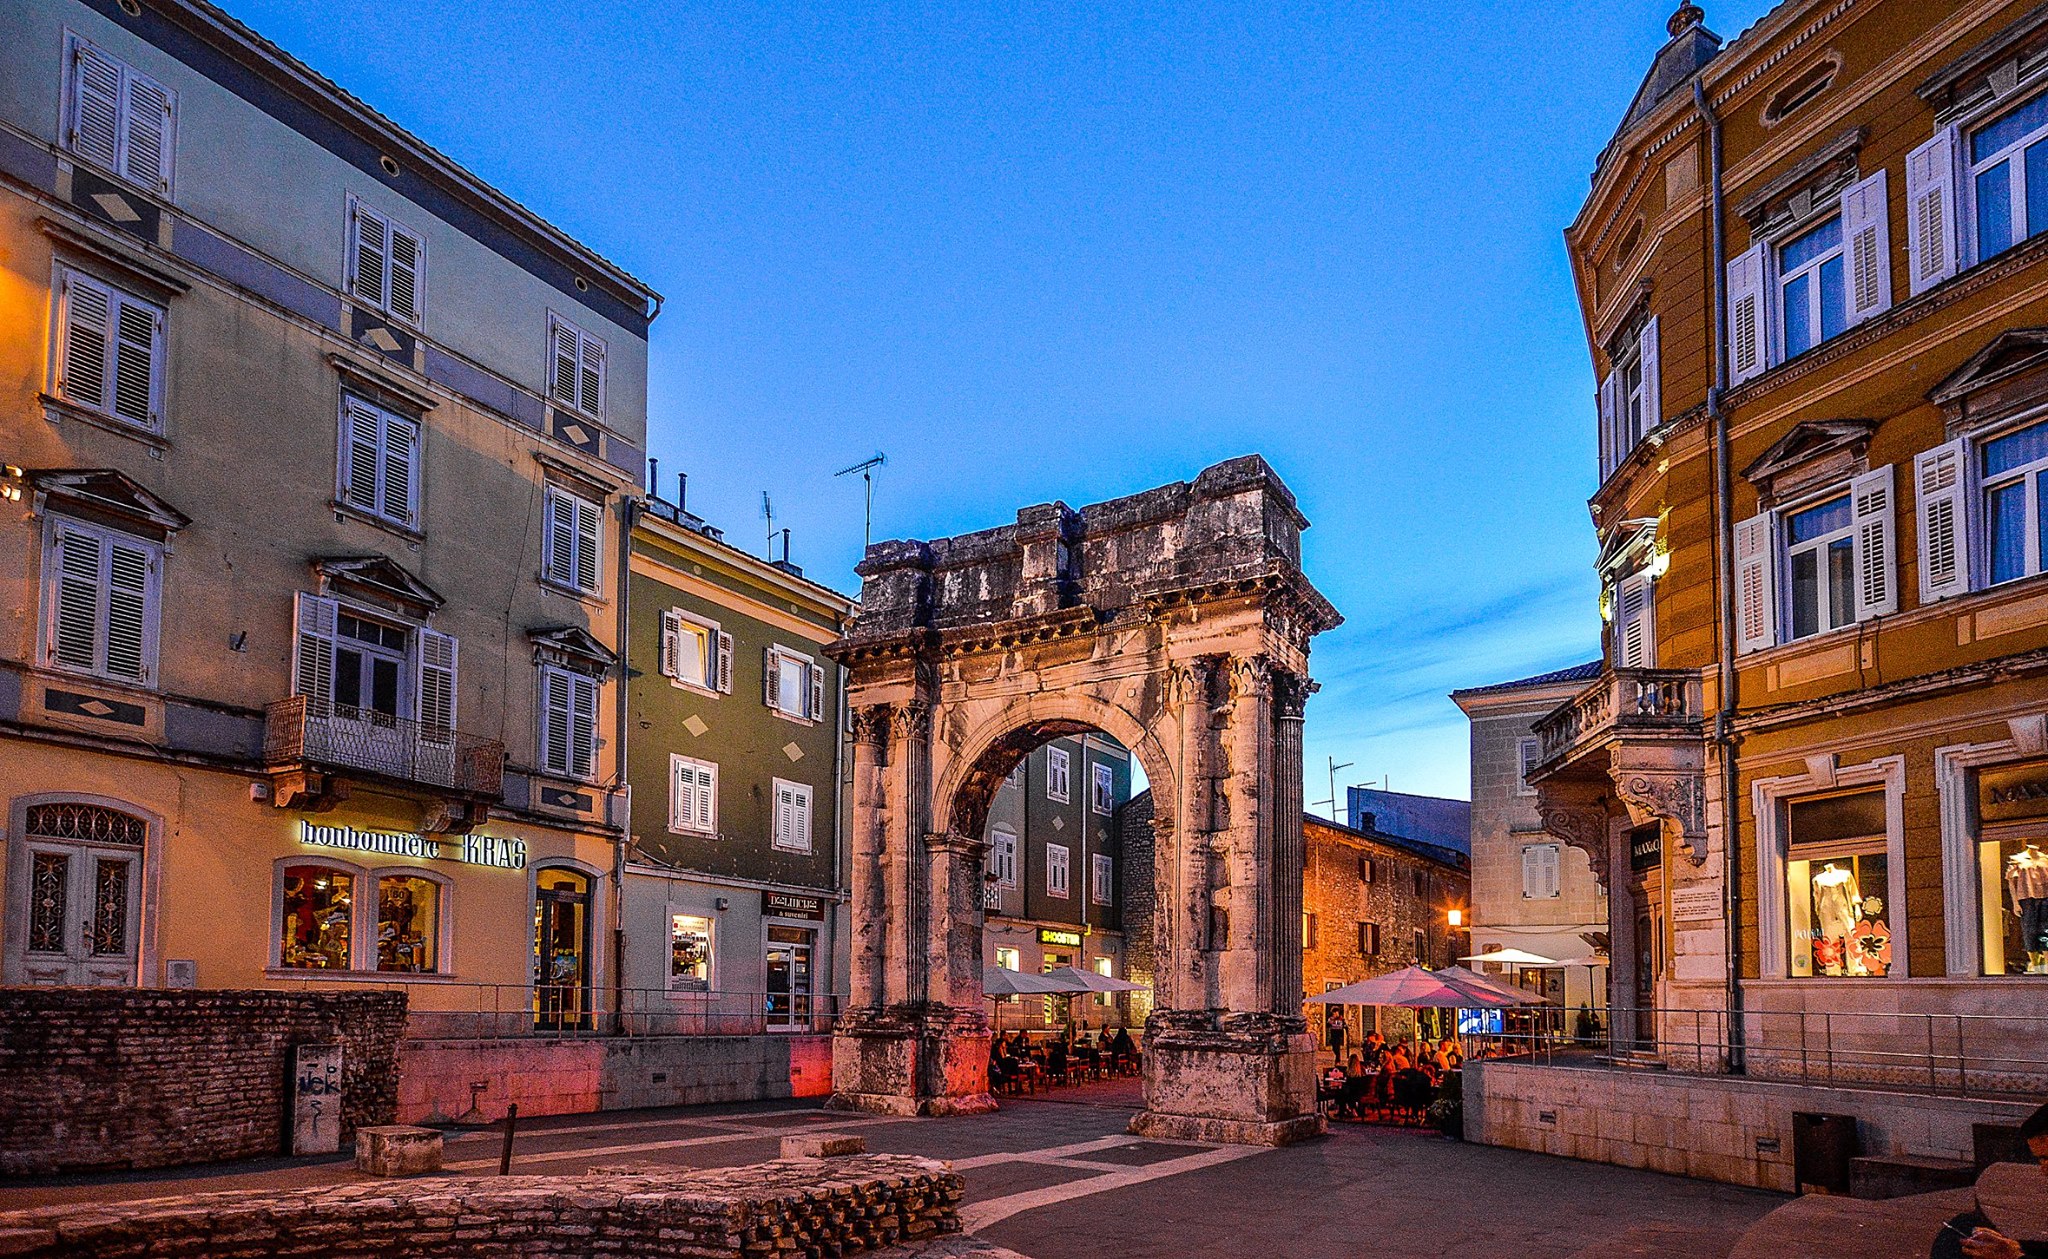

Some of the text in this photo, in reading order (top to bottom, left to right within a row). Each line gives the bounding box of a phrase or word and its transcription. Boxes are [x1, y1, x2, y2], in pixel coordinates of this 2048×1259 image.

[463, 833, 528, 869] KRAŠ
[784, 911, 809, 919] suveniri
[1041, 930, 1080, 946] SHOOSTER
